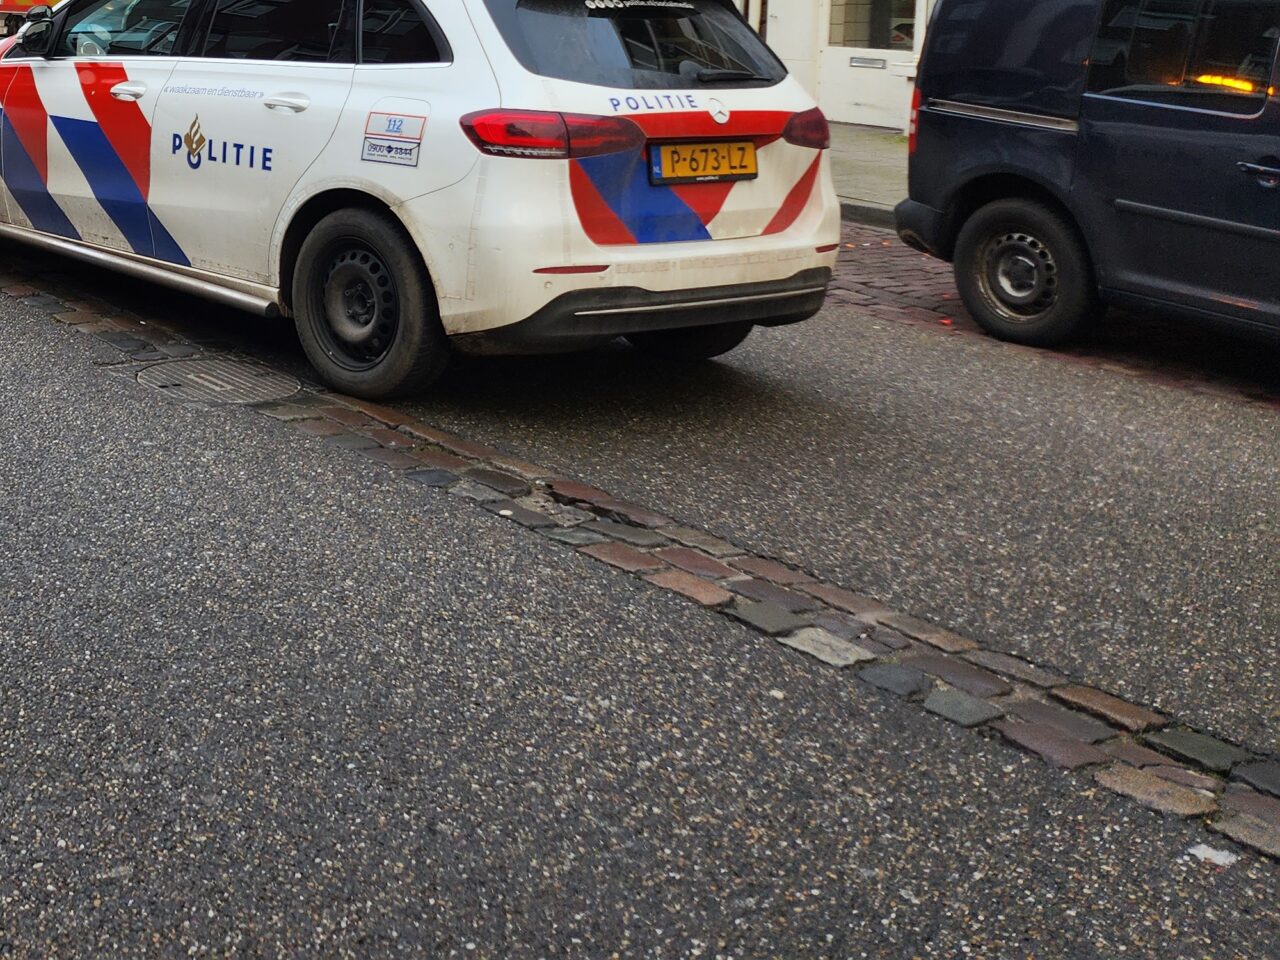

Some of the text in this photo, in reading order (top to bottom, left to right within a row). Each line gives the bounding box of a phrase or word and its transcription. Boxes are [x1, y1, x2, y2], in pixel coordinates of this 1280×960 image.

[217, 87, 258, 98] dienstbaar
[609, 95, 698, 112] POLITIE
[387, 119, 404, 131] 112
[172, 132, 273, 171] POLITIE
[670, 147, 748, 173] P-673-LZ
